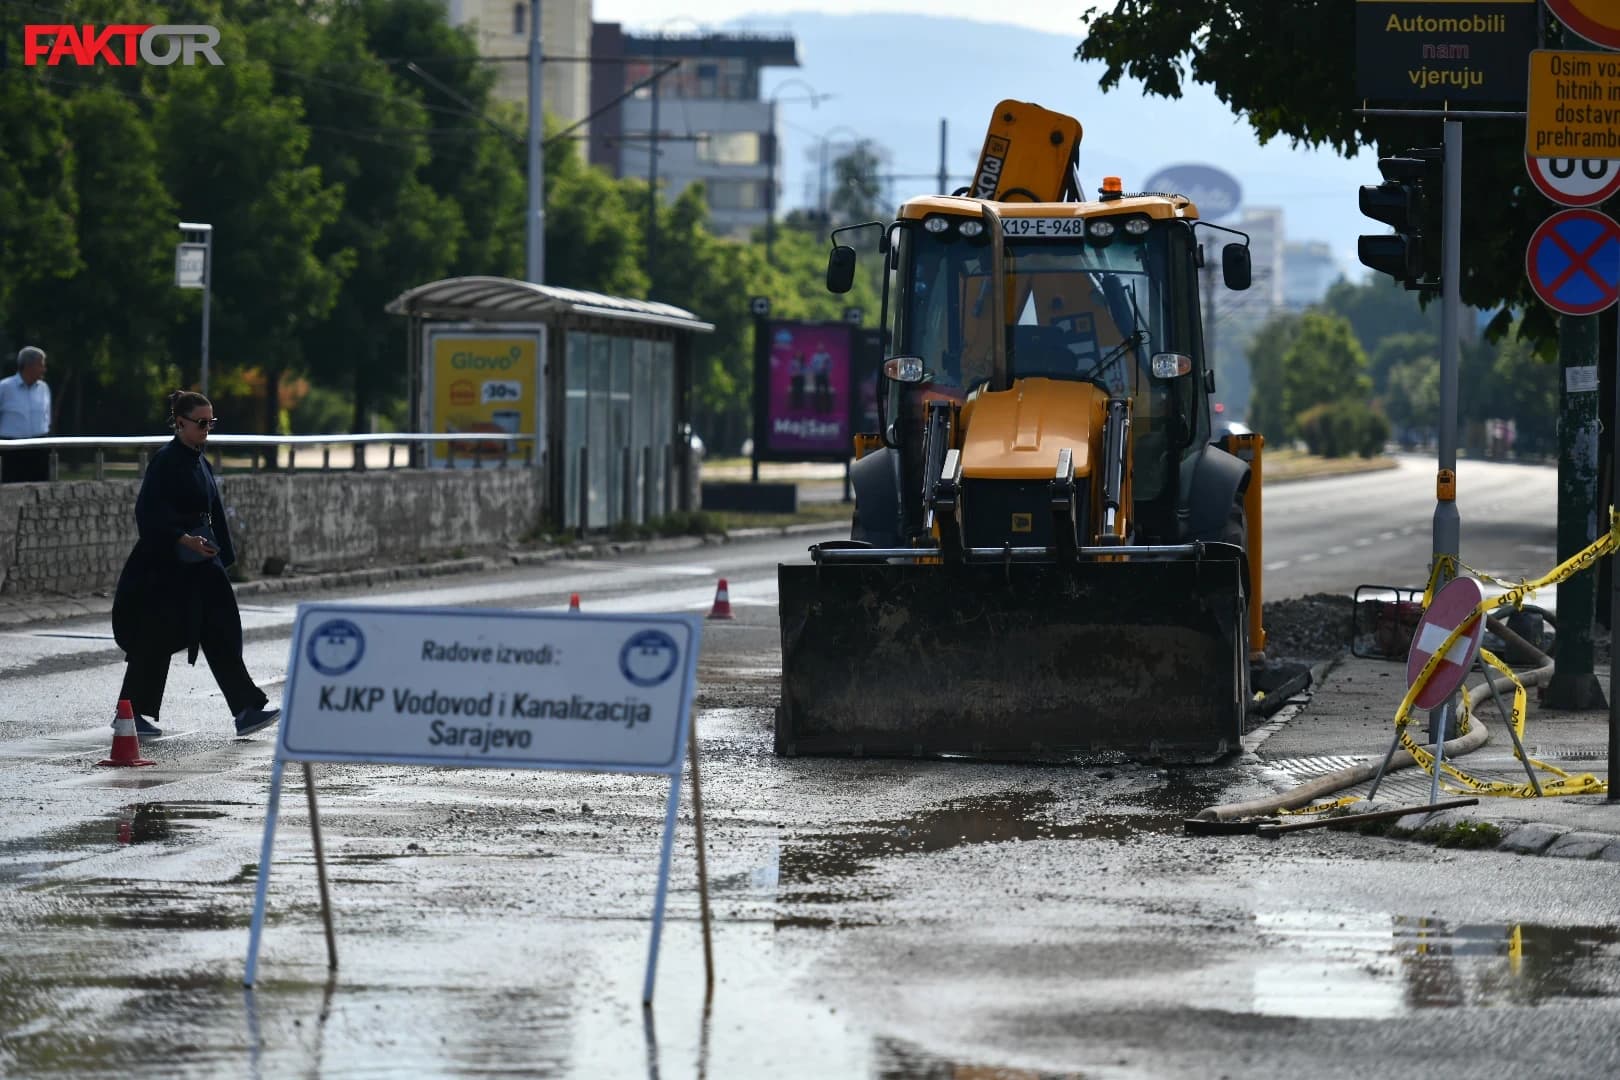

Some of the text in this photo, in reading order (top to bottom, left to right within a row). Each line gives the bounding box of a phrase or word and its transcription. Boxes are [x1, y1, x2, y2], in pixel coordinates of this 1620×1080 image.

[1385, 13, 1505, 33] Automobili
[1422, 43, 1470, 59] nam
[1550, 55, 1591, 76] Osim
[1408, 66, 1484, 89] vjeruju
[1556, 79, 1602, 100] hitnih
[1001, 219, 1082, 235] K19-E-948
[450, 350, 514, 371] Glovo
[421, 639, 562, 665] Radove izvodi:
[318, 685, 652, 728] KJKP Vodovod i Kanalizacija
[428, 719, 533, 752] Sarajevo
